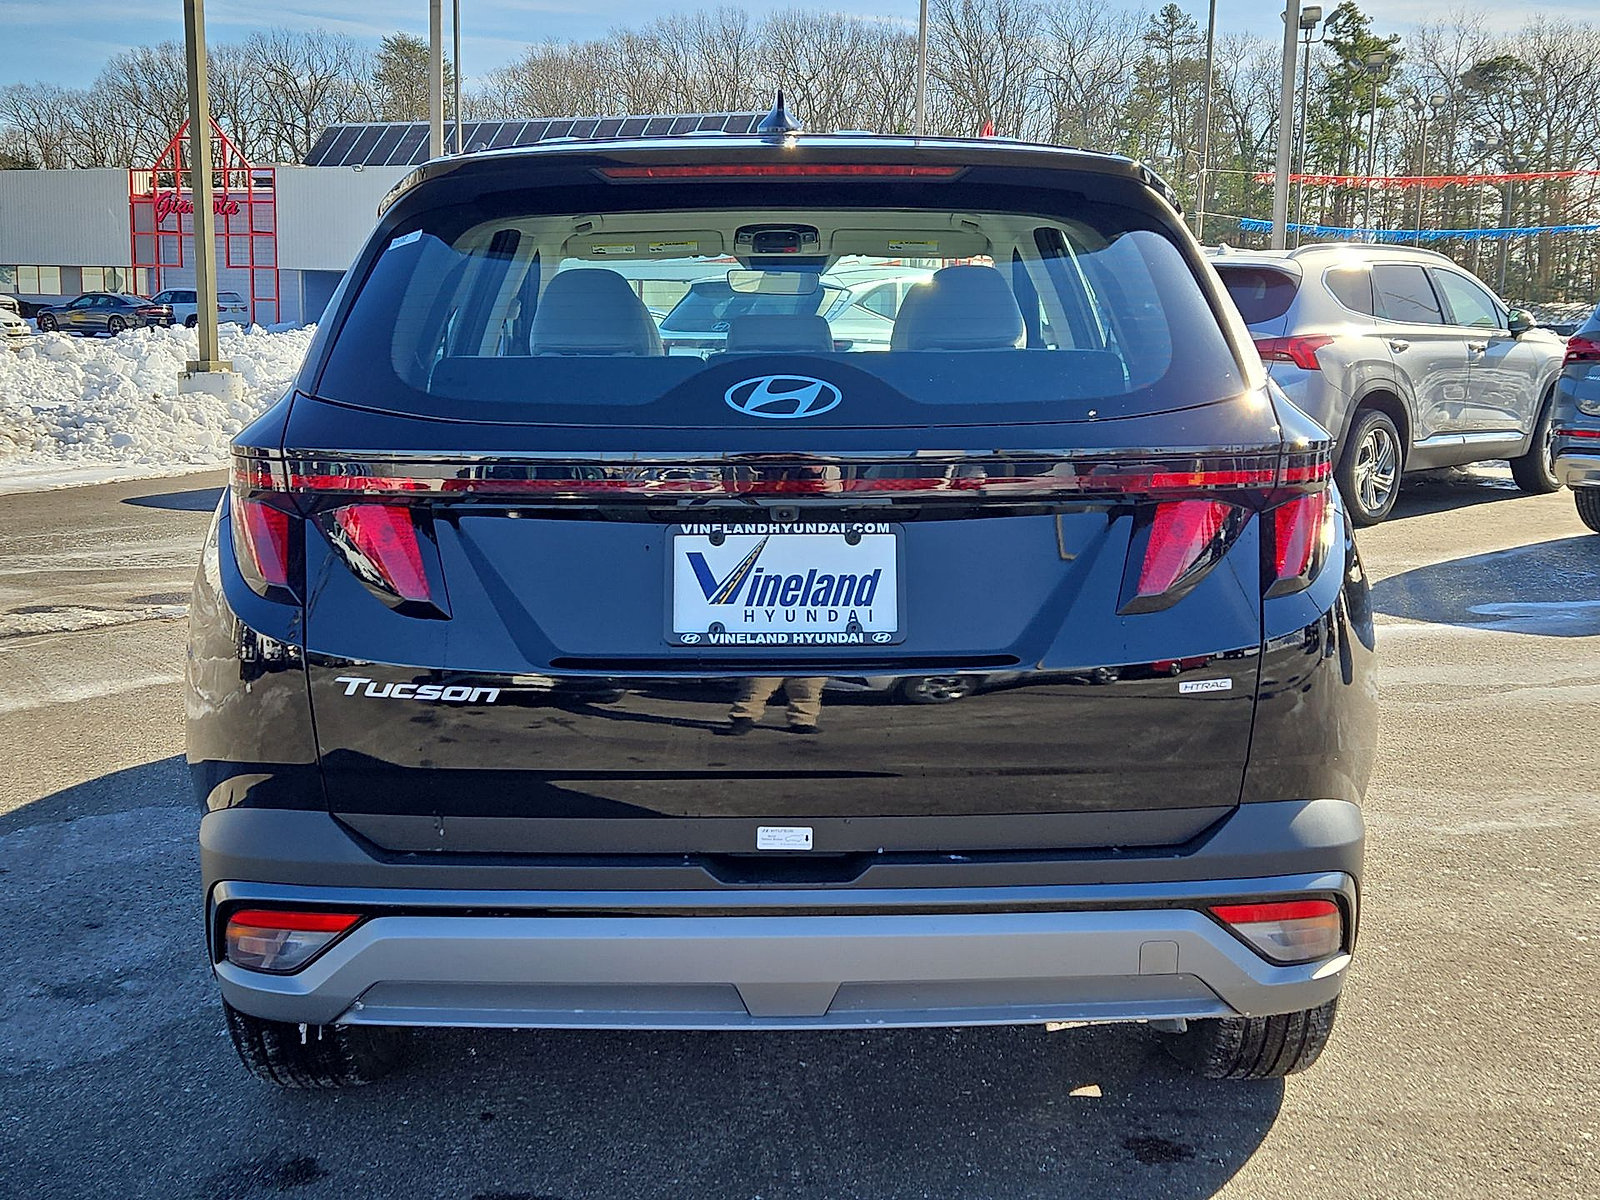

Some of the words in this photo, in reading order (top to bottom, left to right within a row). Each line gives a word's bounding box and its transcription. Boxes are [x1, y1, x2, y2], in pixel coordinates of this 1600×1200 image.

[680, 523, 890, 534] VINELANDHYUNDAI.COM
[685, 535, 882, 607] Vineland
[743, 609, 873, 623] HYUNDAI
[708, 633, 788, 644] VINELAND
[792, 633, 864, 644] HYUNDAI
[1182, 680, 1229, 692] HTRAC
